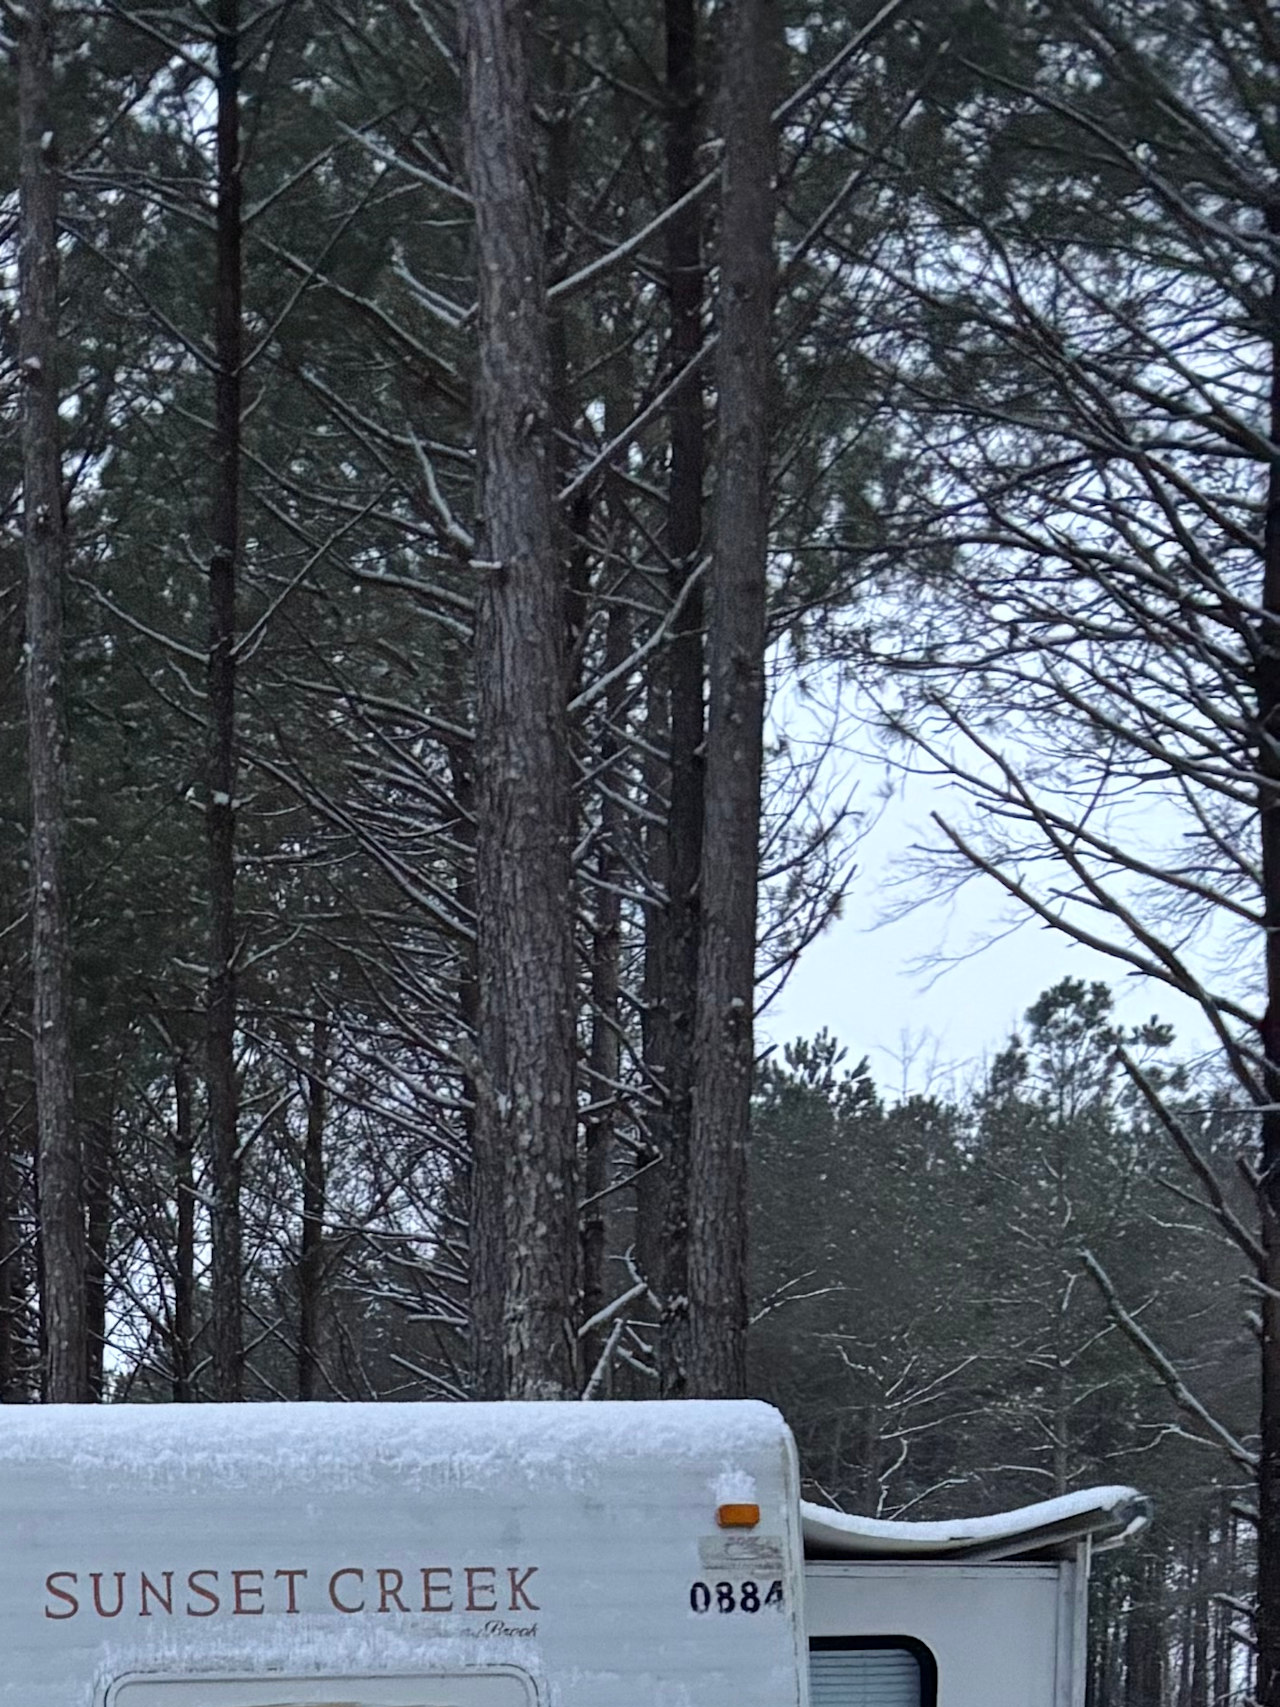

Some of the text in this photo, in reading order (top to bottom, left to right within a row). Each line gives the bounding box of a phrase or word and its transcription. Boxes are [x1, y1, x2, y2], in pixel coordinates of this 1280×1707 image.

[45, 1566, 540, 1620] SUNSET CREEK
[690, 1580, 784, 1614] 0884
